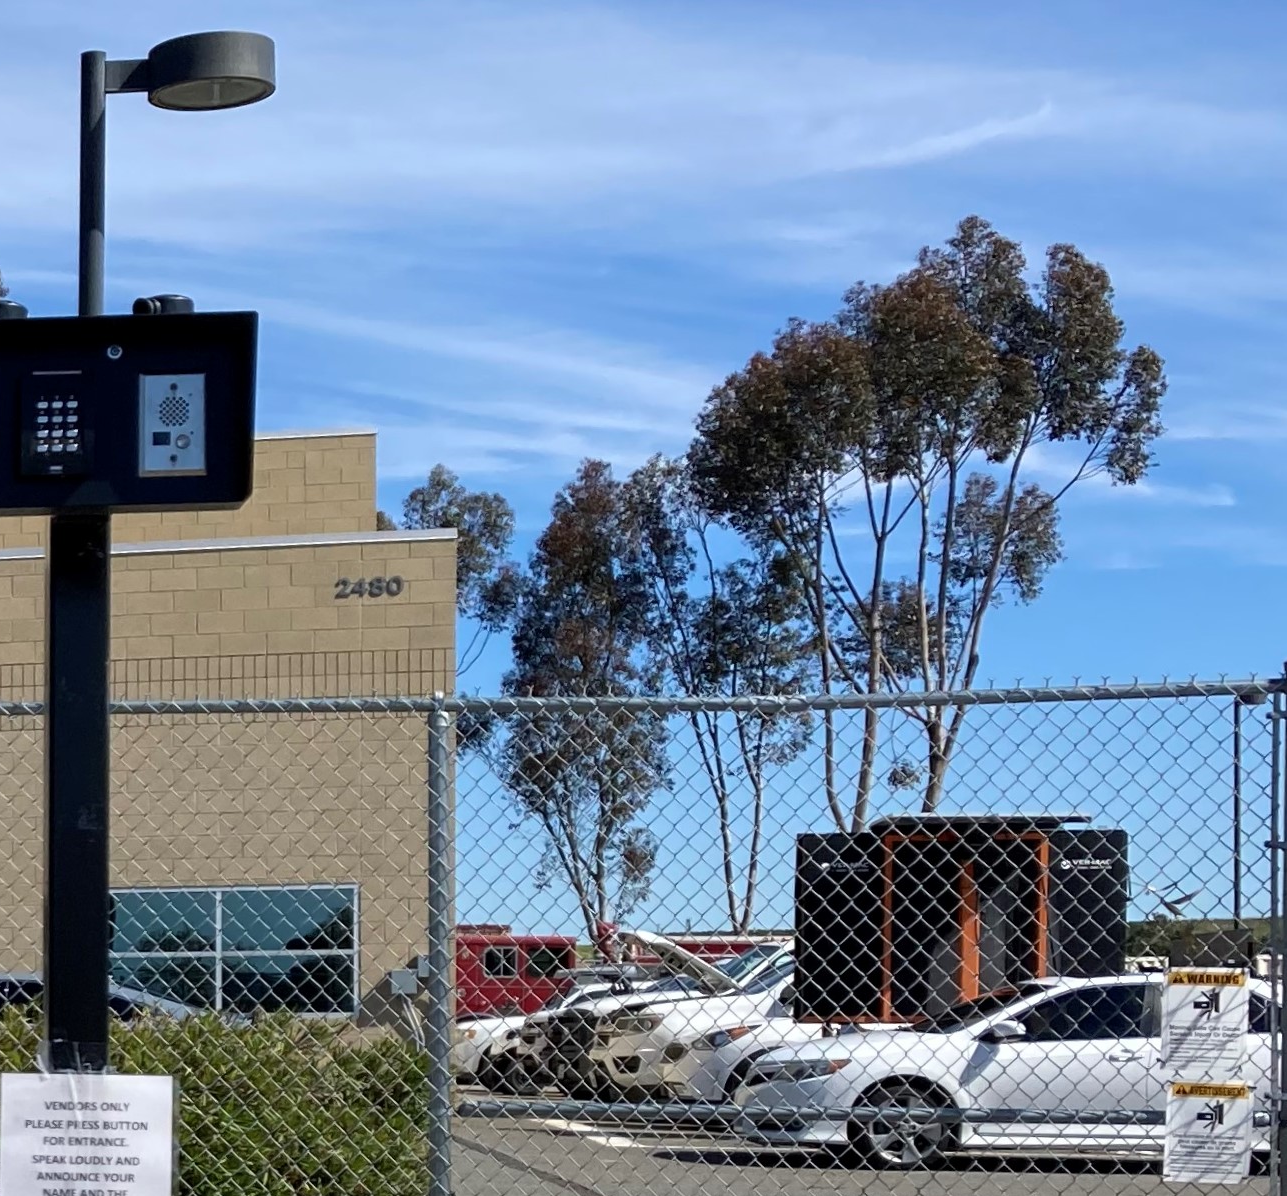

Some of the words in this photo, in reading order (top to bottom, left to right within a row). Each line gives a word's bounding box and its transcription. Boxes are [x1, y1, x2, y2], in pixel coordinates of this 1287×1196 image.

[334, 575, 404, 599] 2480
[1187, 973, 1240, 985] WARNING
[44, 1101, 98, 1111] VENDORS
[100, 1102, 131, 1112] ONLY
[25, 1119, 64, 1129] PLEASE
[103, 1121, 148, 1131] BUTTON
[43, 1137, 65, 1146] FOR
[31, 1155, 67, 1164] SPEAK
[69, 1155, 113, 1165] LOUDLY
[115, 1156, 141, 1166] AND
[36, 1172, 101, 1182] ANNOUNCE
[104, 1173, 135, 1182] YOUR
